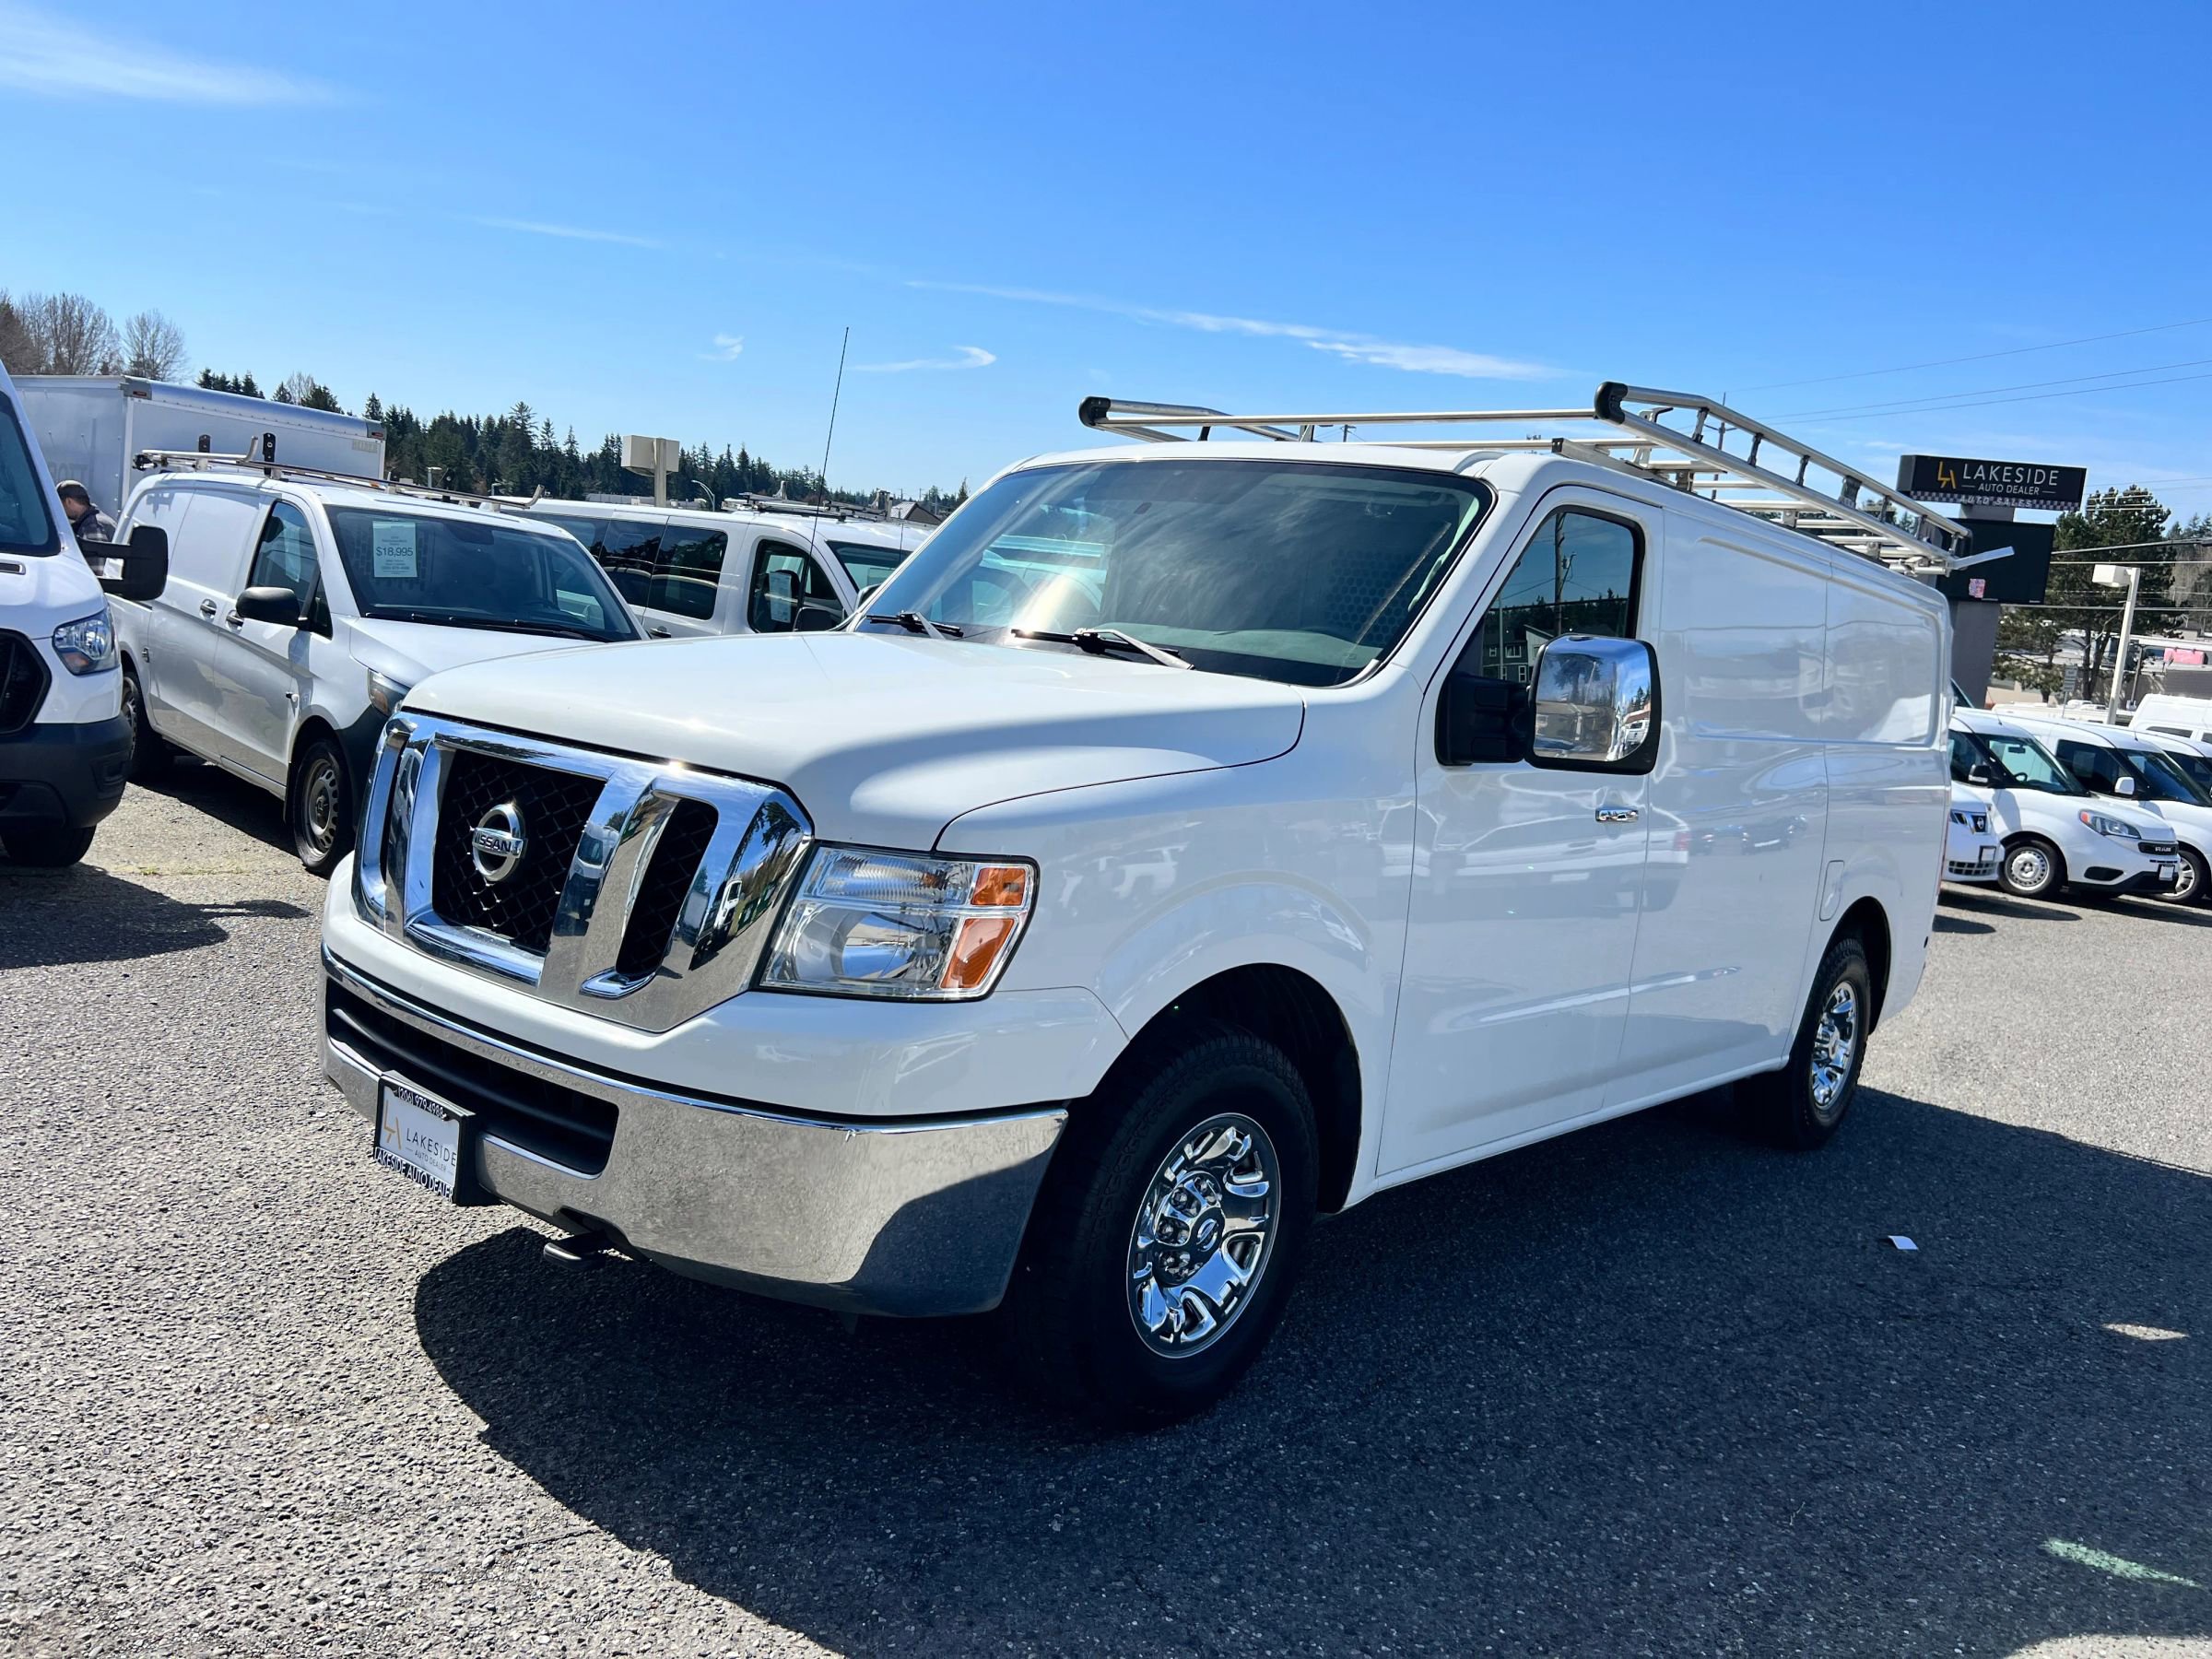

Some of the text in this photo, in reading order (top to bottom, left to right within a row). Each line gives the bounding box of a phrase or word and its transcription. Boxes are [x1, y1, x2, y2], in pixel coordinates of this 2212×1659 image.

[1962, 463, 2060, 486] LAKESIDE
[1978, 483, 2040, 496] AUTO DEALER
[1960, 494, 2032, 508] AUTO SALES
[376, 546, 414, 557] $18,995
[474, 830, 512, 853] NISSAN
[406, 1127, 457, 1167] LAKESIDE
[414, 1149, 429, 1163] AUTO
[374, 1147, 453, 1203] LAKESIDE AUTO DEALER
